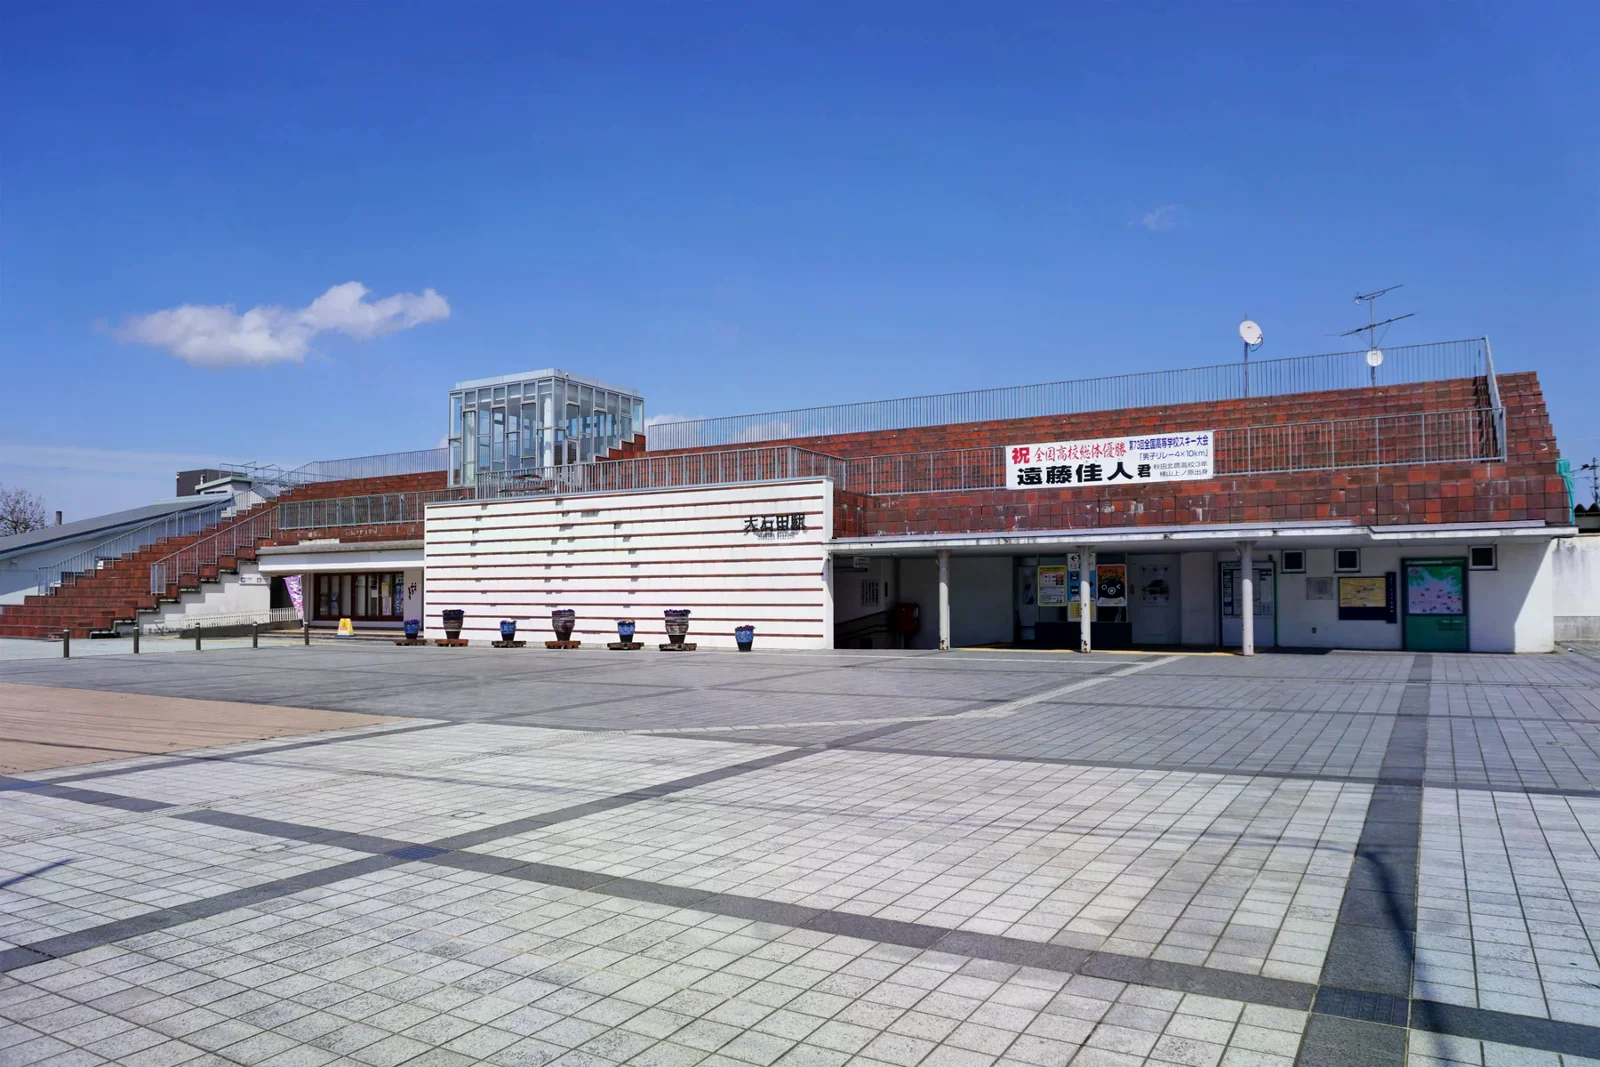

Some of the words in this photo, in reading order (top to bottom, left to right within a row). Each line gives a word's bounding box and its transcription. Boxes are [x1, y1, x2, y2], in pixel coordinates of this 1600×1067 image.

[1012, 447, 1030, 464] 祝
[1034, 441, 1127, 463] 全国高校総体優勝
[1129, 435, 1209, 451] 第73回全国高等学校スキー大会
[743, 512, 807, 531] 大石田駅
